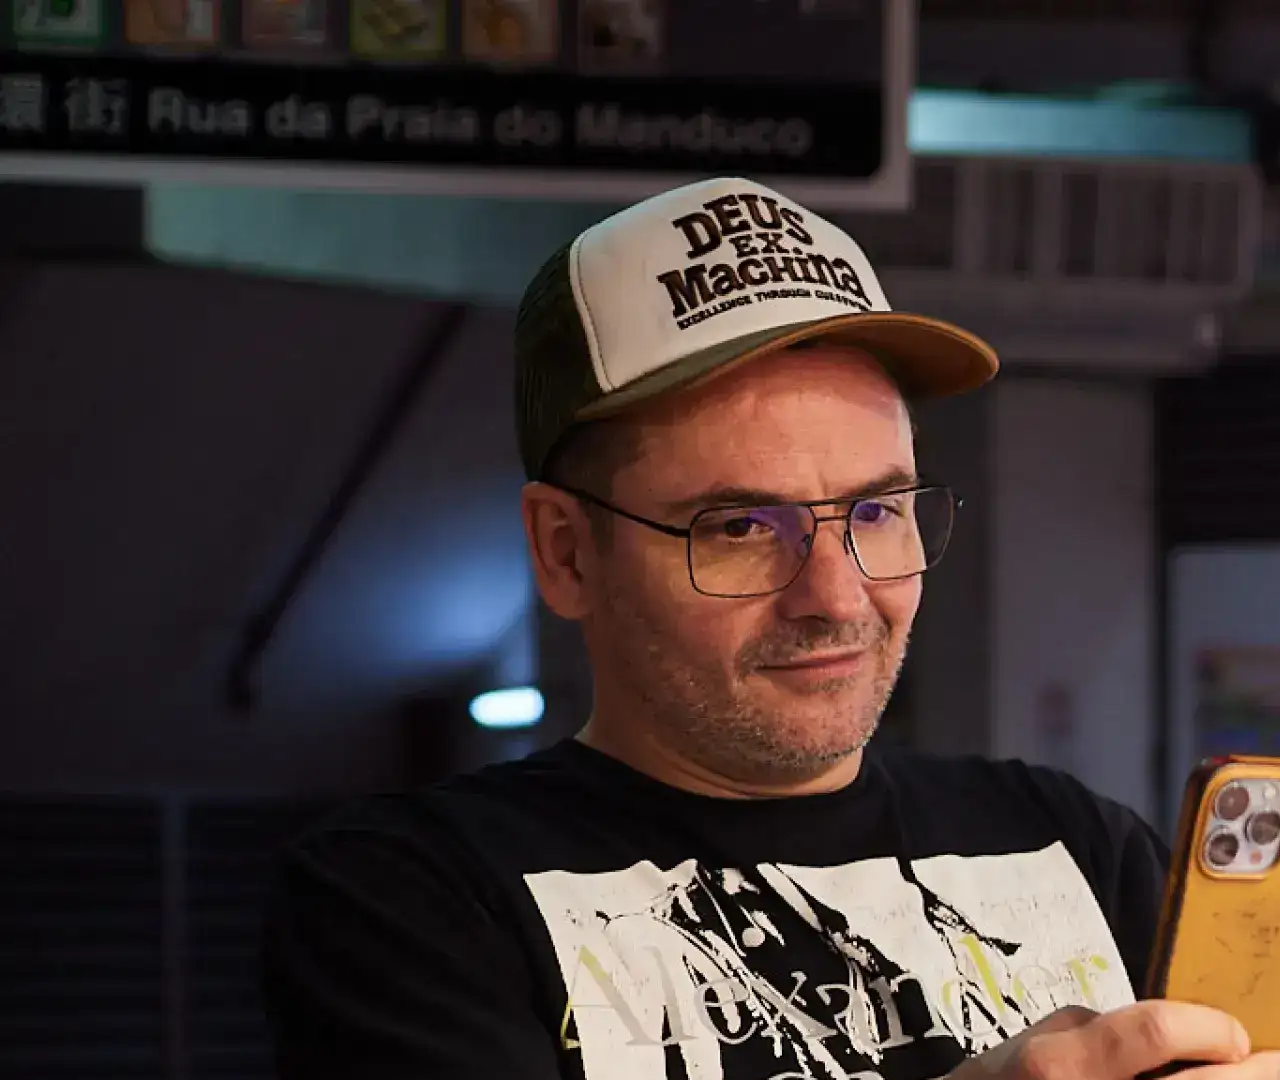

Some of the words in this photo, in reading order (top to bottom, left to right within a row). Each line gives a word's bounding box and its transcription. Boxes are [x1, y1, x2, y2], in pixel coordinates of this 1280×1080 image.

[148, 87, 249, 137] Rua
[265, 94, 331, 138] da
[346, 94, 481, 144] Praia
[494, 104, 563, 146] do
[672, 193, 814, 259] DEUS
[676, 295, 753, 331] EXCELLENCE
